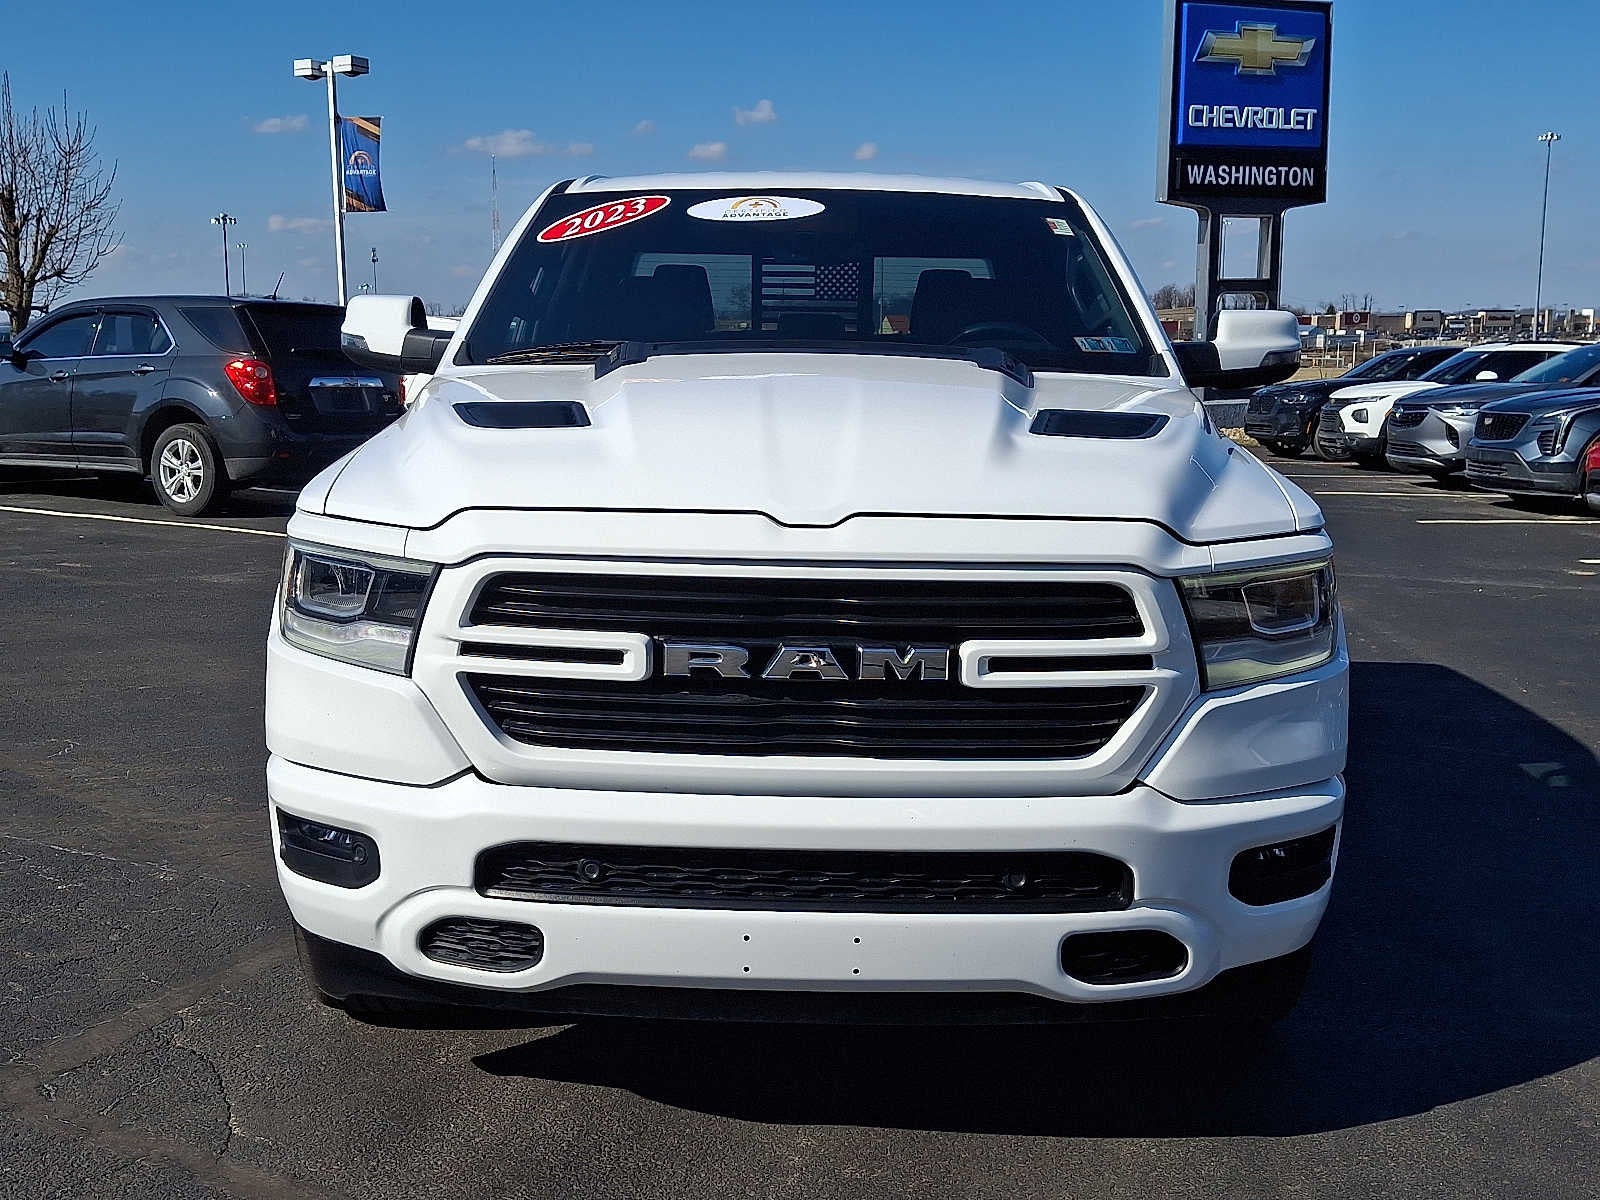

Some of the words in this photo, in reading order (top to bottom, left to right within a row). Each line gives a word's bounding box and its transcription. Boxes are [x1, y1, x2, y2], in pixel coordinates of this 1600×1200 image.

[1188, 104, 1318, 130] CHEVROLET
[1187, 164, 1315, 187] WASHINGTON
[561, 198, 647, 238] 2023
[663, 641, 950, 681] RAM
